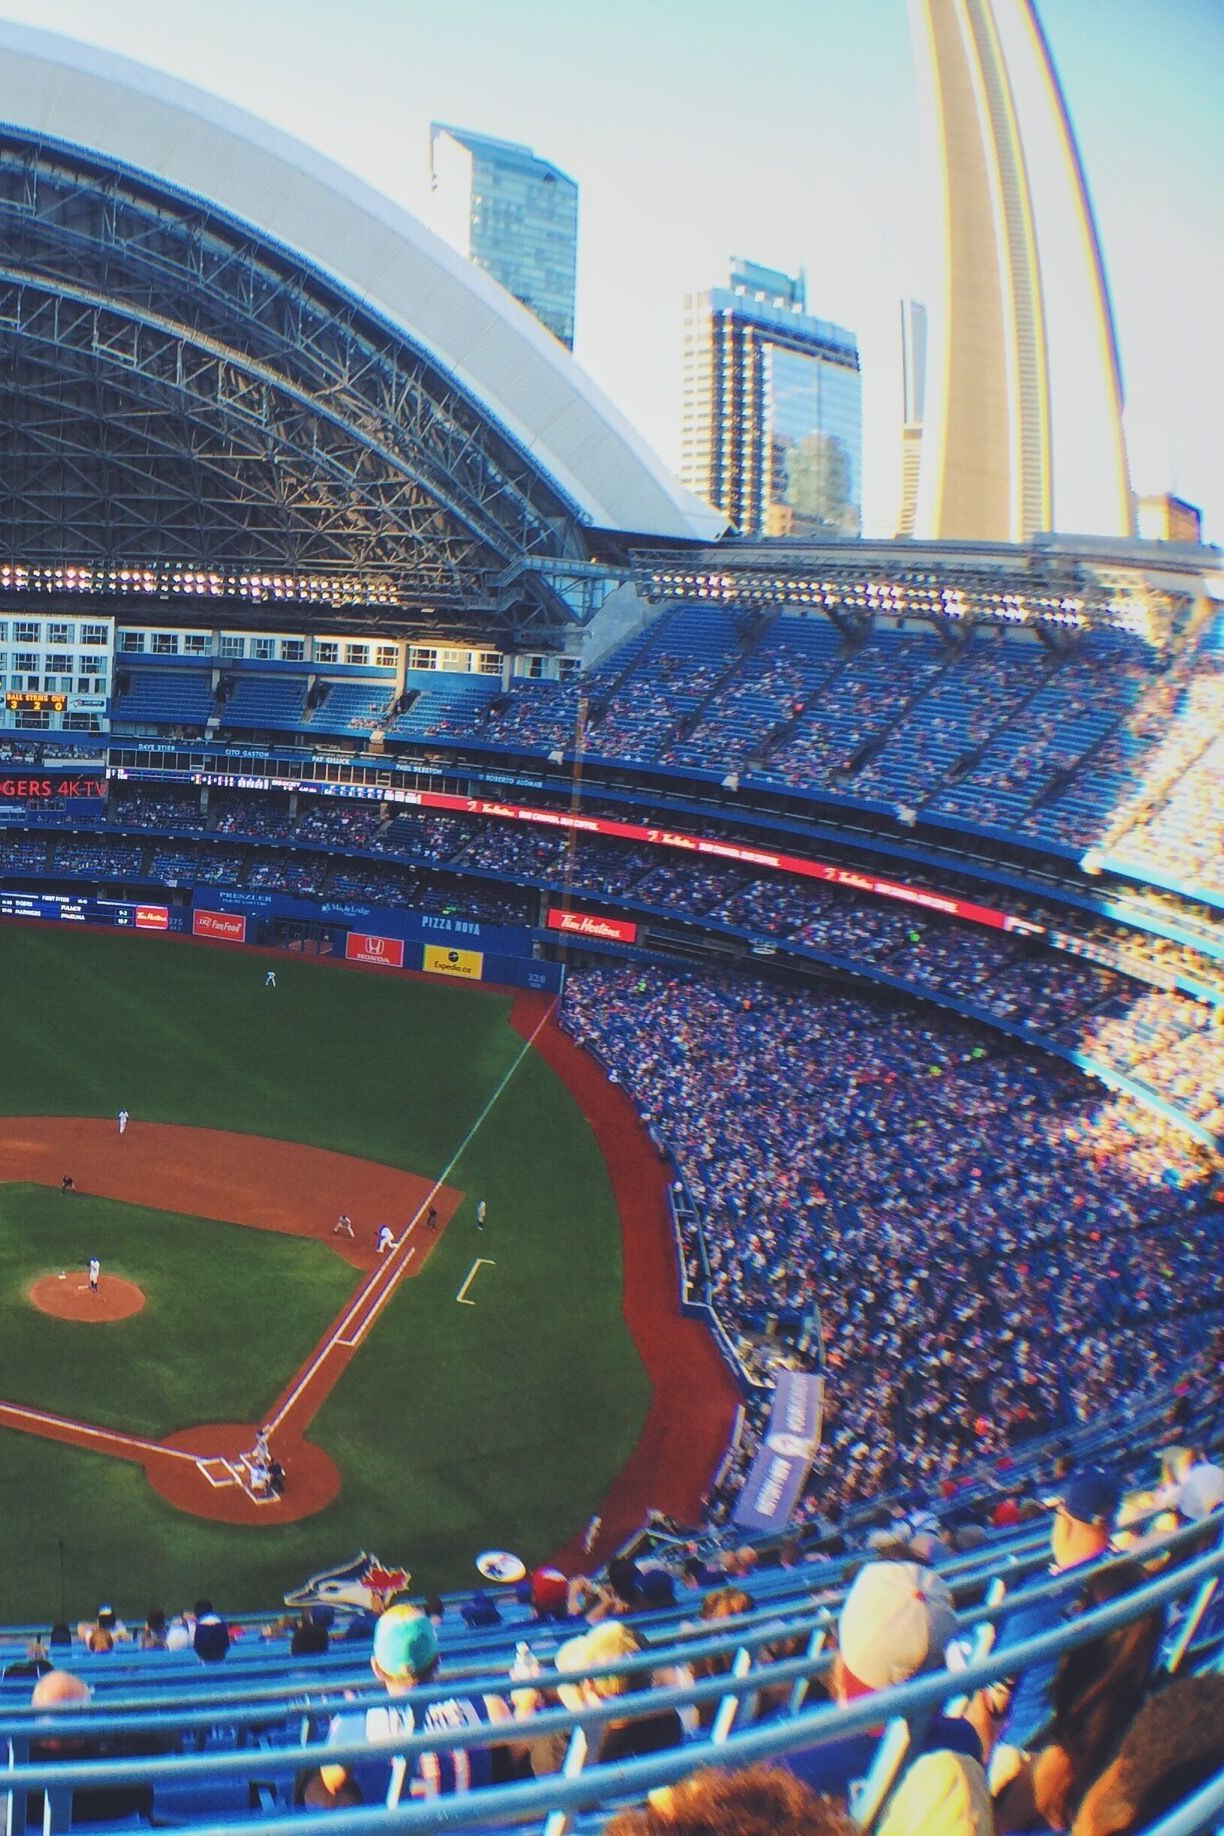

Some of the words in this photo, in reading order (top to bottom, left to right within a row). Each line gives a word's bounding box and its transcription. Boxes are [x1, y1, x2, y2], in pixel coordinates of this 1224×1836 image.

[6, 693, 23, 701] BALL
[25, 694, 49, 702] STRIKE
[51, 695, 66, 703] OUT
[10, 700, 18, 710] 3
[33, 701, 41, 710] 2
[54, 702, 62, 711] 0
[84, 780, 109, 797] TV
[421, 915, 452, 930] PIZZA
[454, 920, 481, 935] NOVA
[560, 914, 581, 930] Tim
[580, 917, 621, 938] Hortons
[356, 953, 390, 964] HONDA
[433, 960, 472, 974] Expedia.ca
